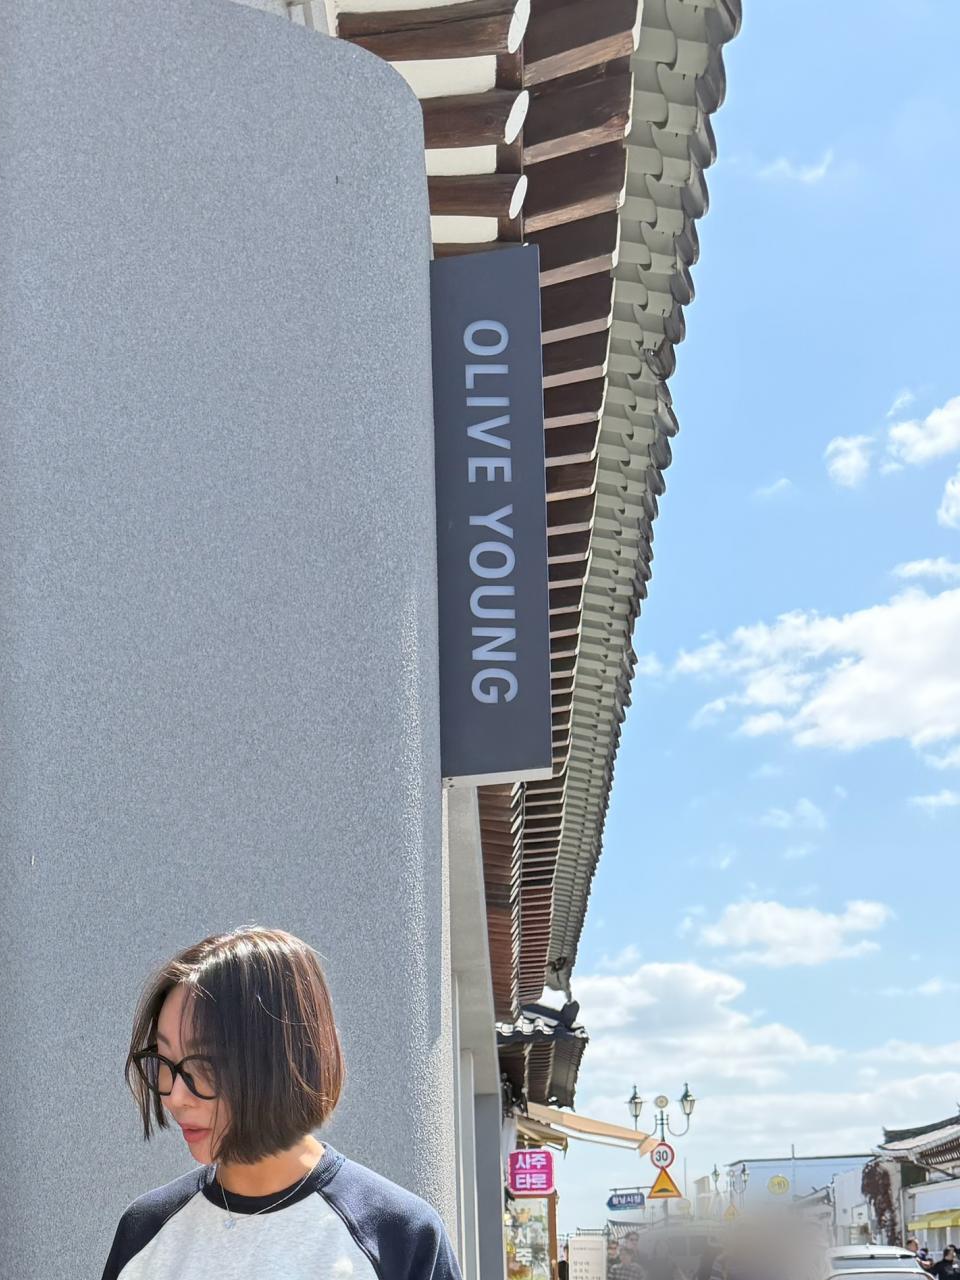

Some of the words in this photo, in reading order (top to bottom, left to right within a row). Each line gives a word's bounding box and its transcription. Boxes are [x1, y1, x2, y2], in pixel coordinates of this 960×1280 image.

[462, 318, 513, 483] OLIVE
[468, 503, 519, 705] YOUNG
[515, 1153, 547, 1170] 사주
[655, 1150, 669, 1162] 30
[515, 1173, 547, 1189] 타로
